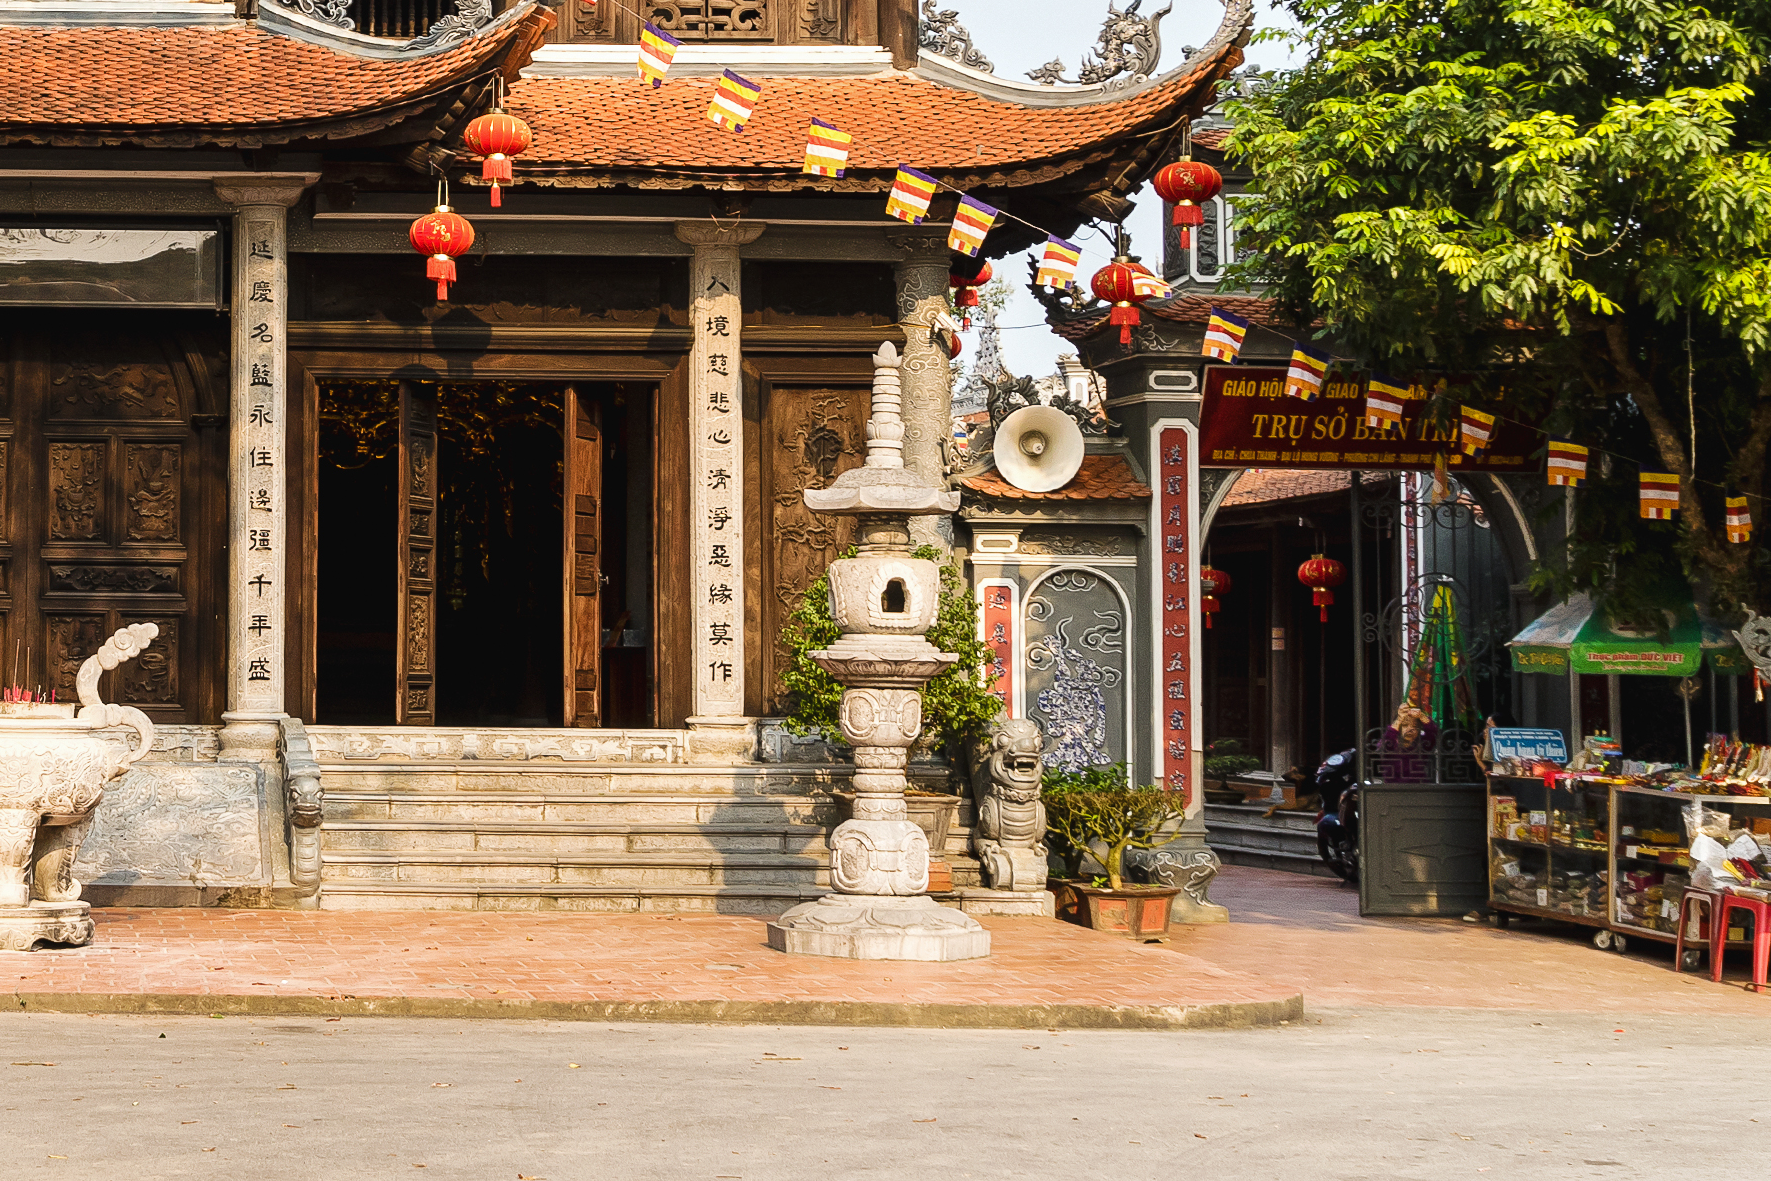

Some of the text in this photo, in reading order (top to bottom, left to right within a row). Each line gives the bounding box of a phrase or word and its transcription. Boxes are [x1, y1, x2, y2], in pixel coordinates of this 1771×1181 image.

[1223, 376, 1256, 397] GIÁO
[1259, 378, 1283, 401] HỘI
[1252, 414, 1308, 446] TRỤ
[1312, 406, 1349, 441] SỞ
